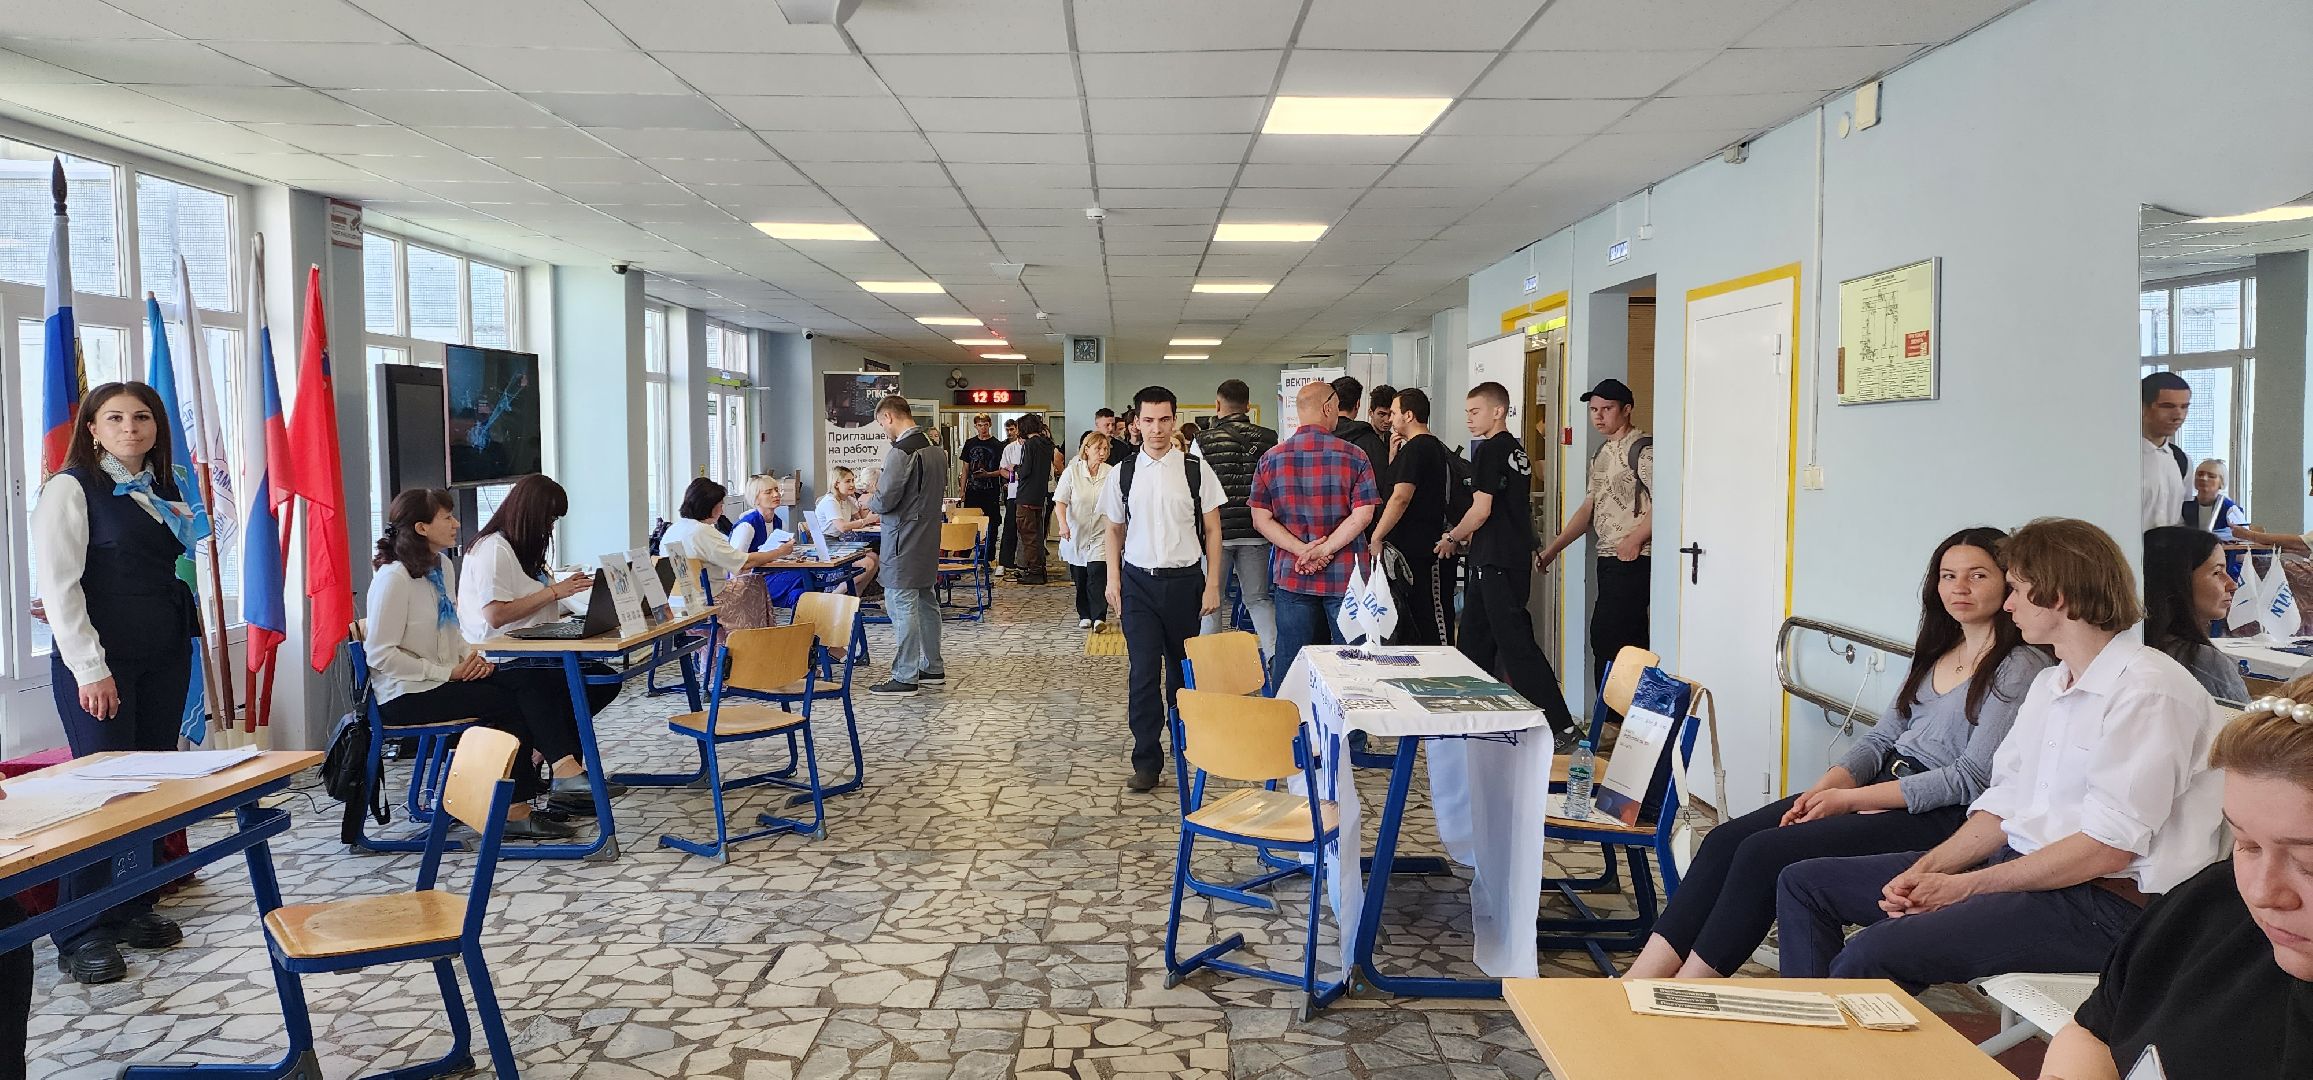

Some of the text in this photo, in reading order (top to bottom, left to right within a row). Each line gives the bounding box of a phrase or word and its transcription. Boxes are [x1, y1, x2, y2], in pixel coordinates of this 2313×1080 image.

[867, 390, 887, 399] РПКБ
[972, 391, 1010, 403] 12 59
[828, 443, 879, 456] на работу
[1344, 591, 1360, 621] АГИ
